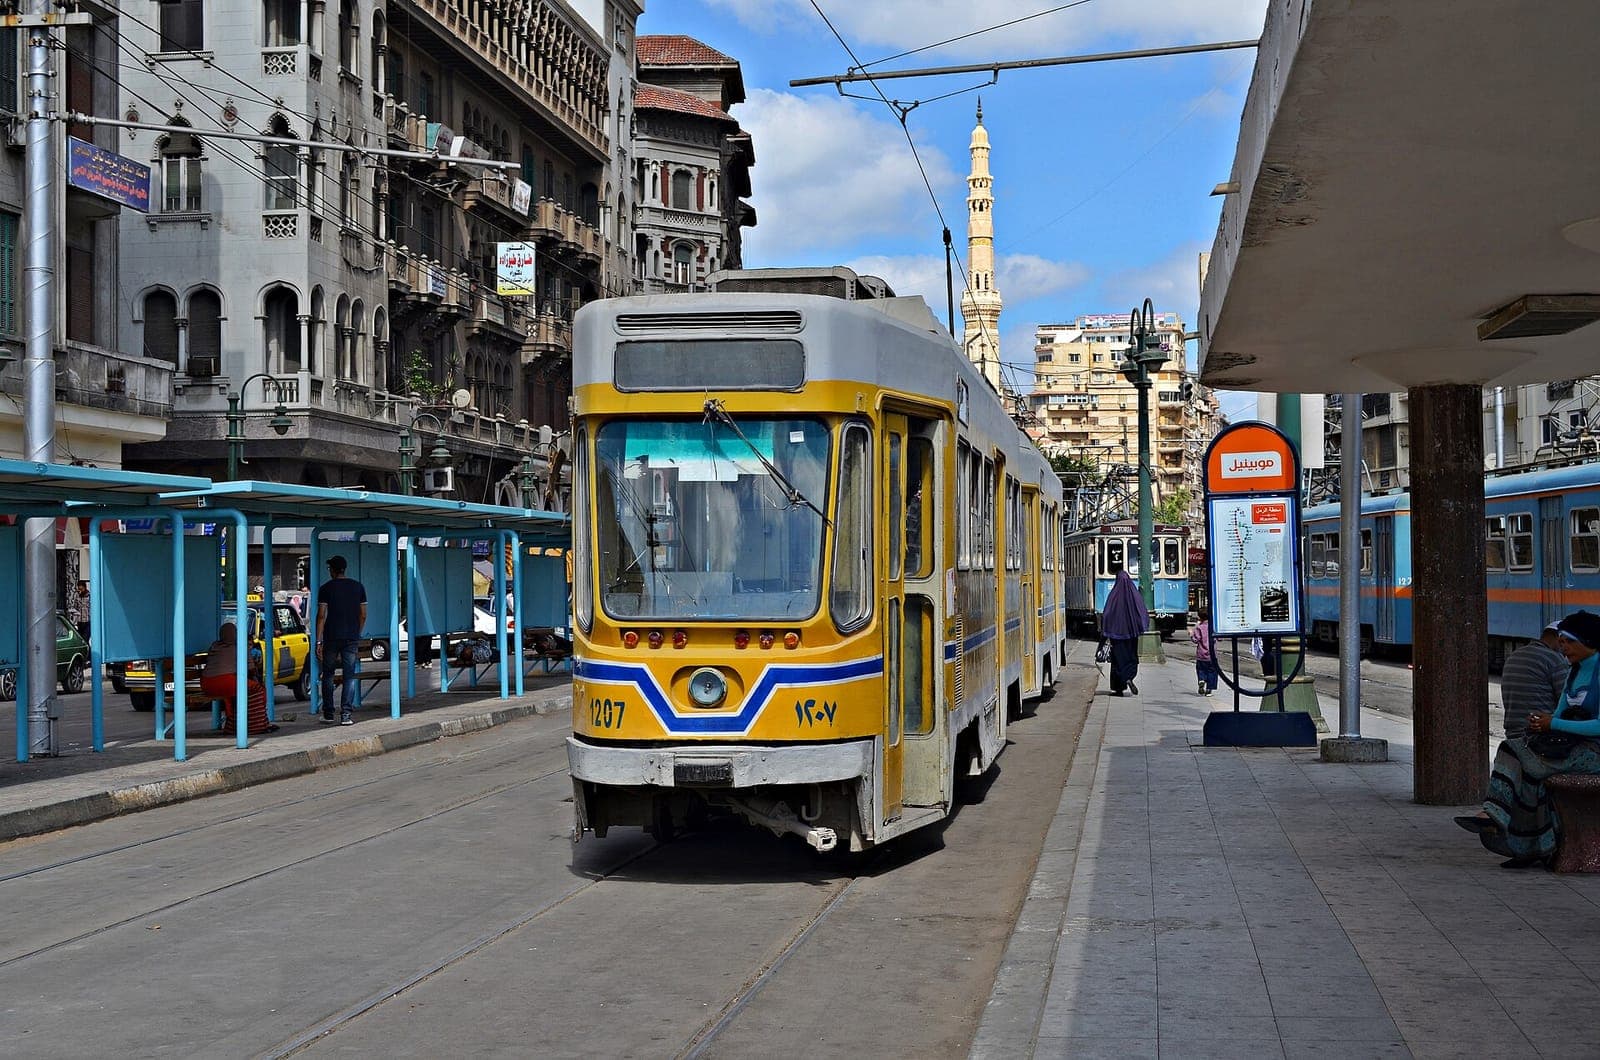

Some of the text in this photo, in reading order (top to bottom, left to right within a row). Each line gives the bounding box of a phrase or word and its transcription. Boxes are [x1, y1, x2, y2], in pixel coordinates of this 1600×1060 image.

[1229, 457, 1274, 474] موبينيل
[589, 698, 625, 729] 1207
[795, 699, 837, 729] ١٢٠٧
